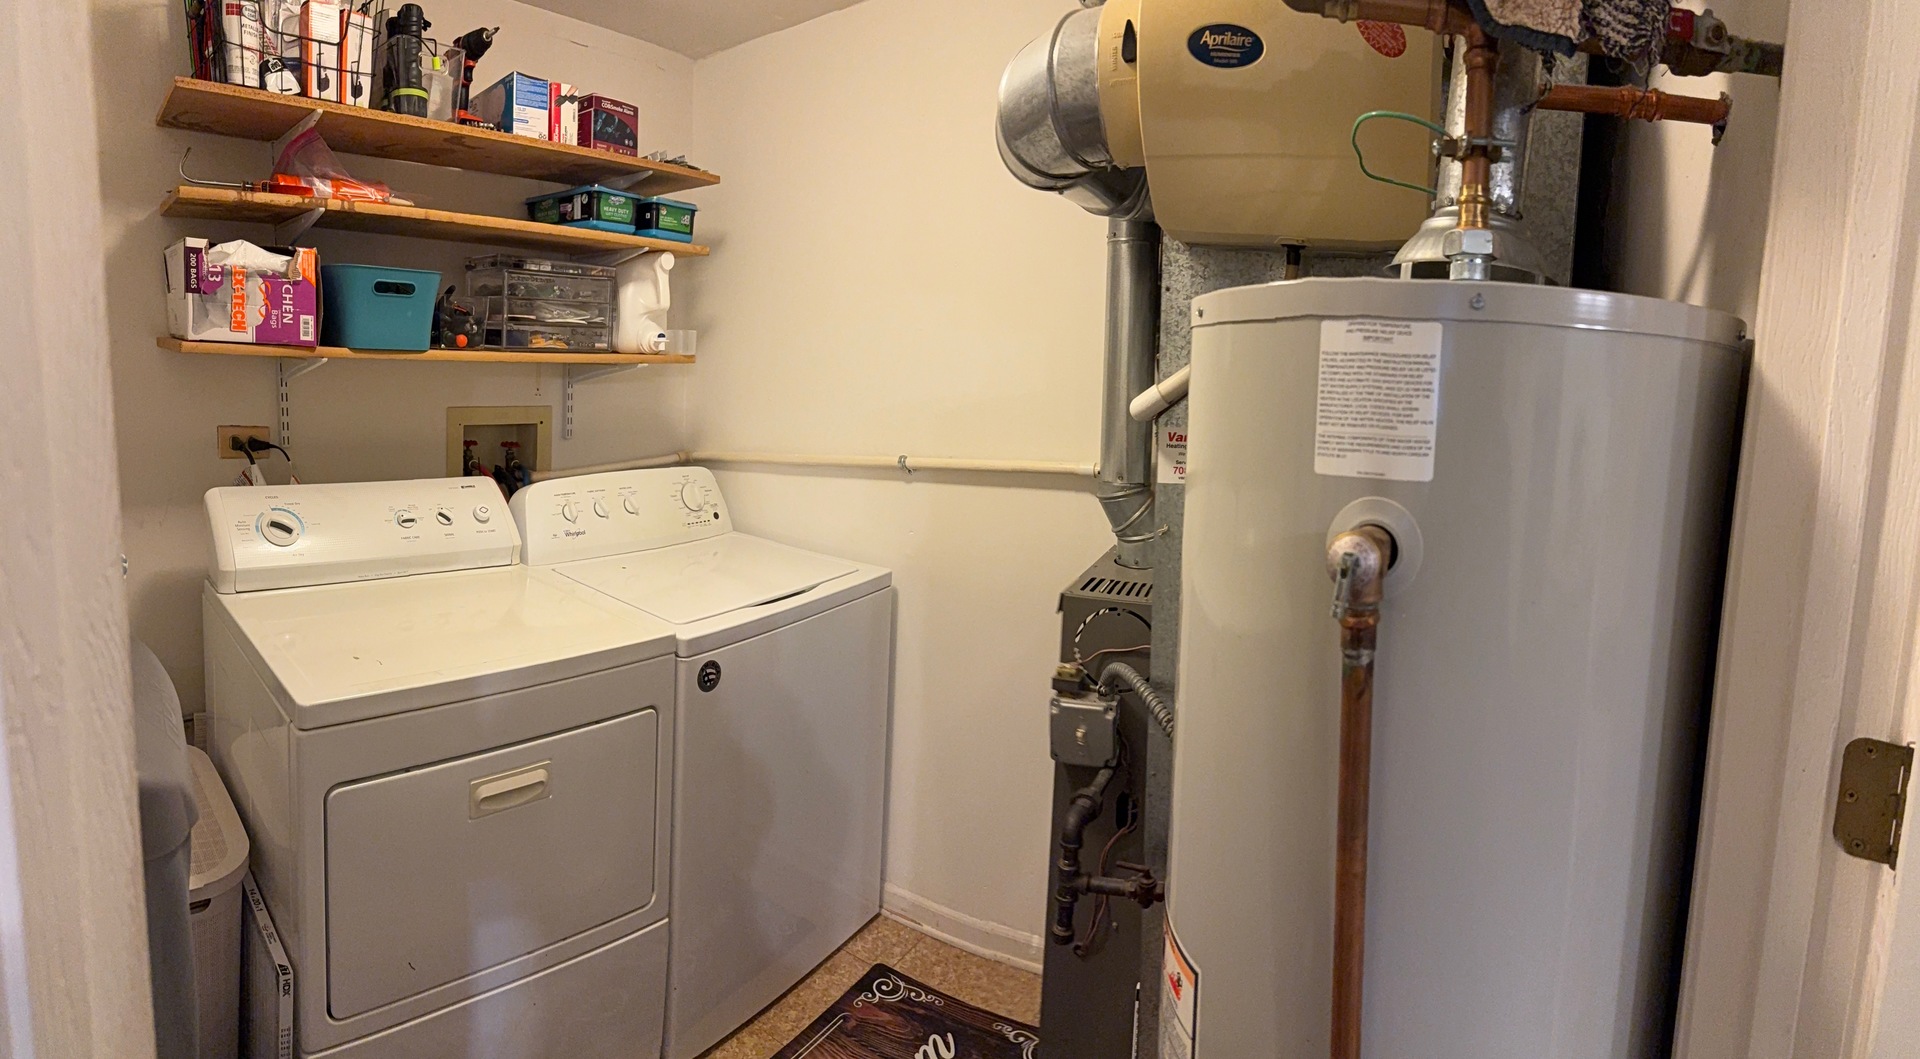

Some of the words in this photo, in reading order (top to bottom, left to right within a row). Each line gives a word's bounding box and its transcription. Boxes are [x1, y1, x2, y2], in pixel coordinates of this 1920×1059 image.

[1200, 30, 1253, 49] Aprilaire
[190, 267, 198, 289] BAGS
[208, 264, 222, 282] 13
[270, 309, 279, 329] Bags
[563, 529, 586, 538] Whirlpool
[282, 978, 292, 998] HDX
